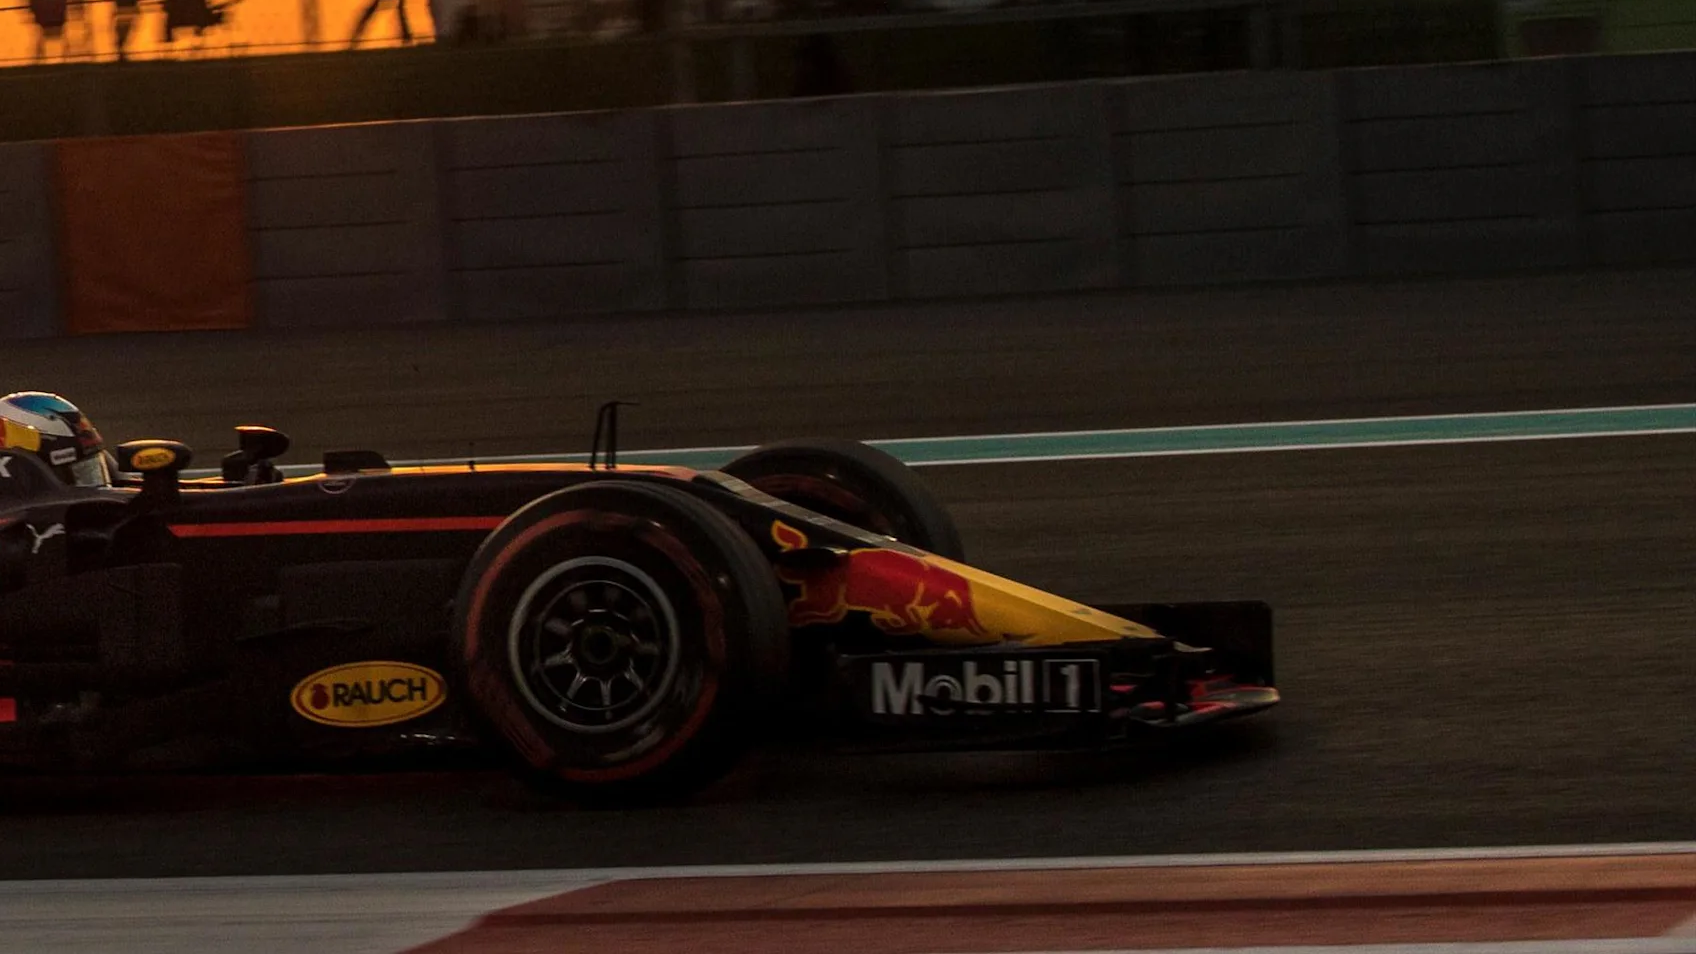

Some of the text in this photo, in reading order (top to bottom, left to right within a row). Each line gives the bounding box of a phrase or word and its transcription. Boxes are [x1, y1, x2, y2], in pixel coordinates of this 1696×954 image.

[332, 677, 427, 707] RAUCH
[870, 659, 1081, 715] Mobil 1
